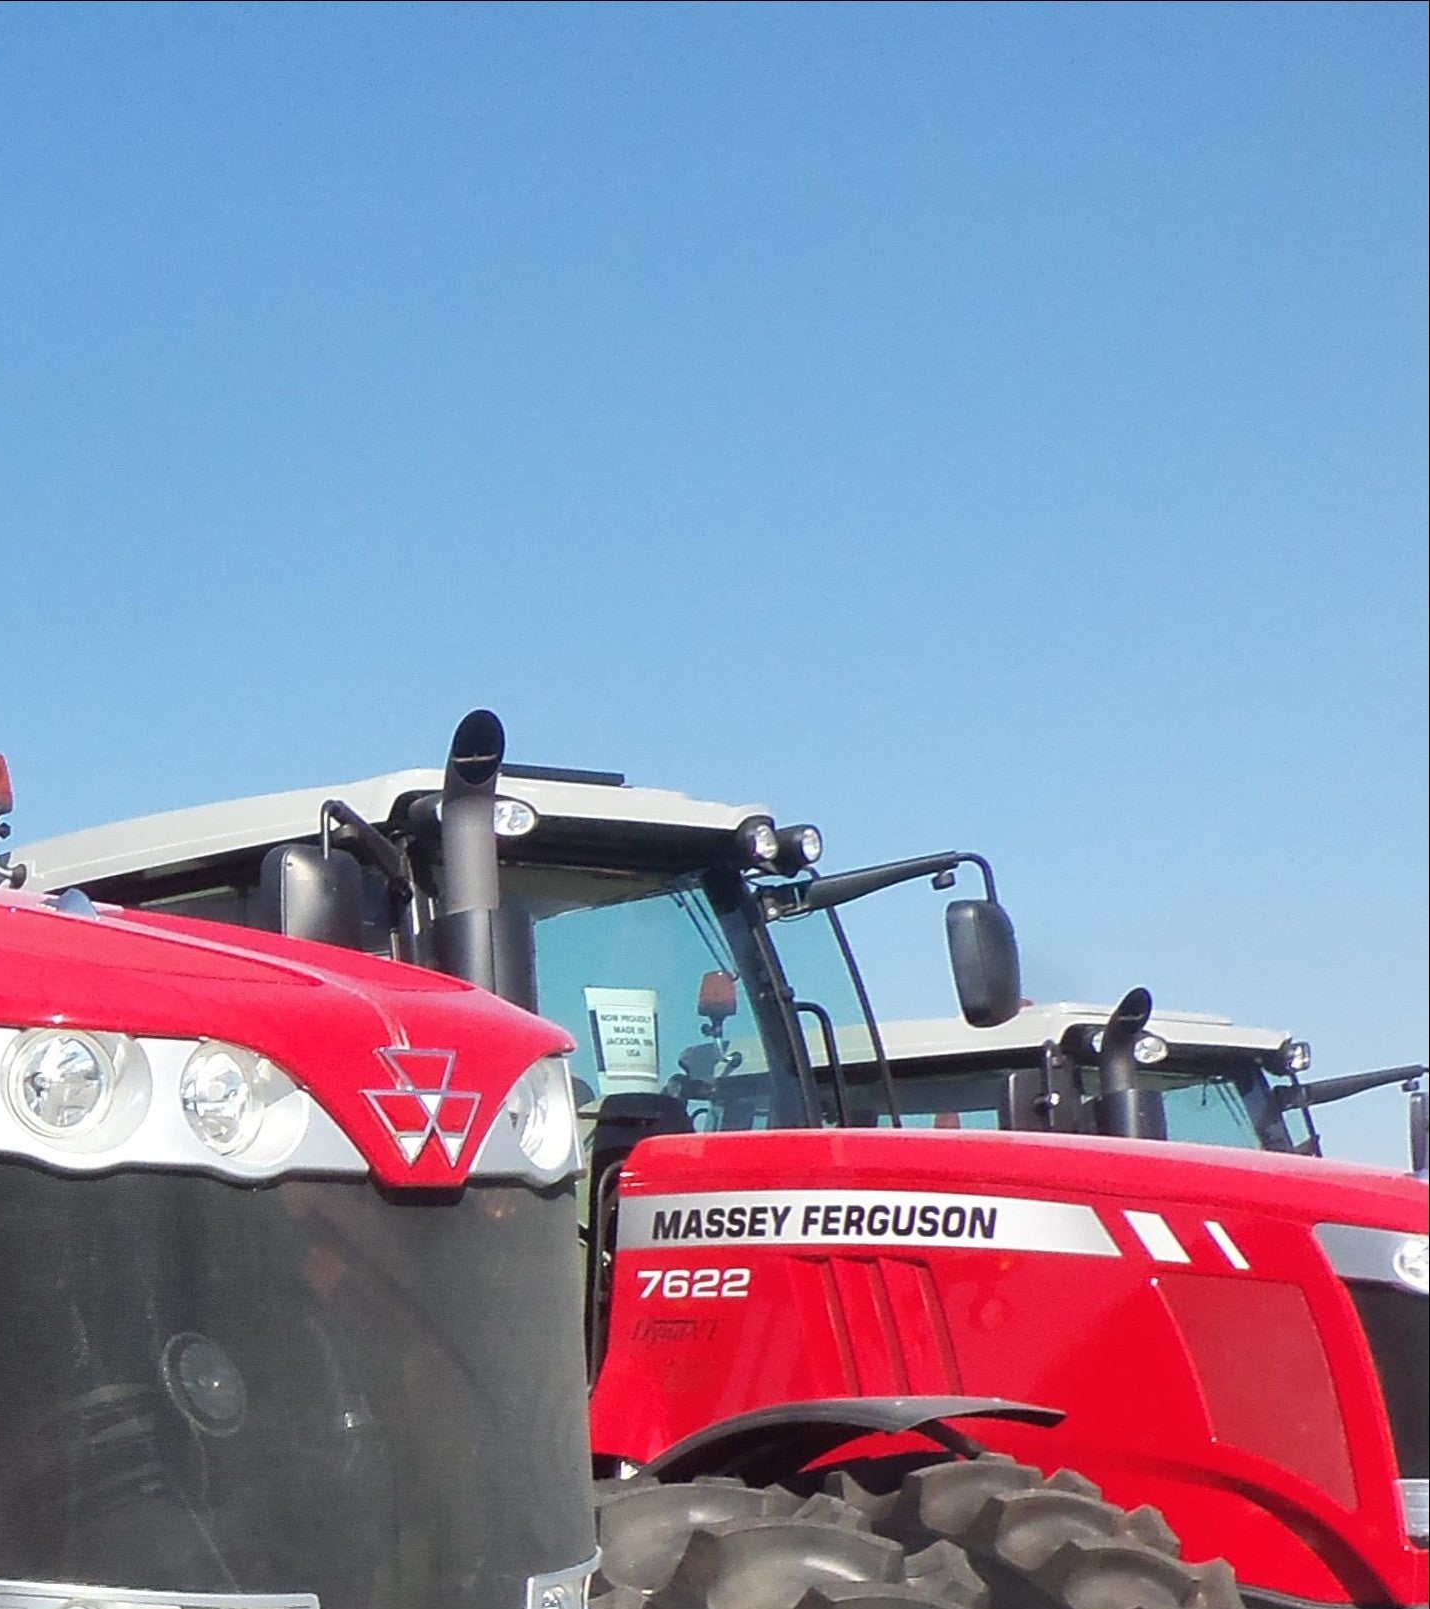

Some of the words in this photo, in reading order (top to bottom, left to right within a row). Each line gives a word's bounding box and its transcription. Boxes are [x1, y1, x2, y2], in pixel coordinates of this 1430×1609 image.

[652, 1205, 791, 1240] MASSEY
[801, 1205, 997, 1239] FERGUSON
[636, 1268, 751, 1298] 7622
